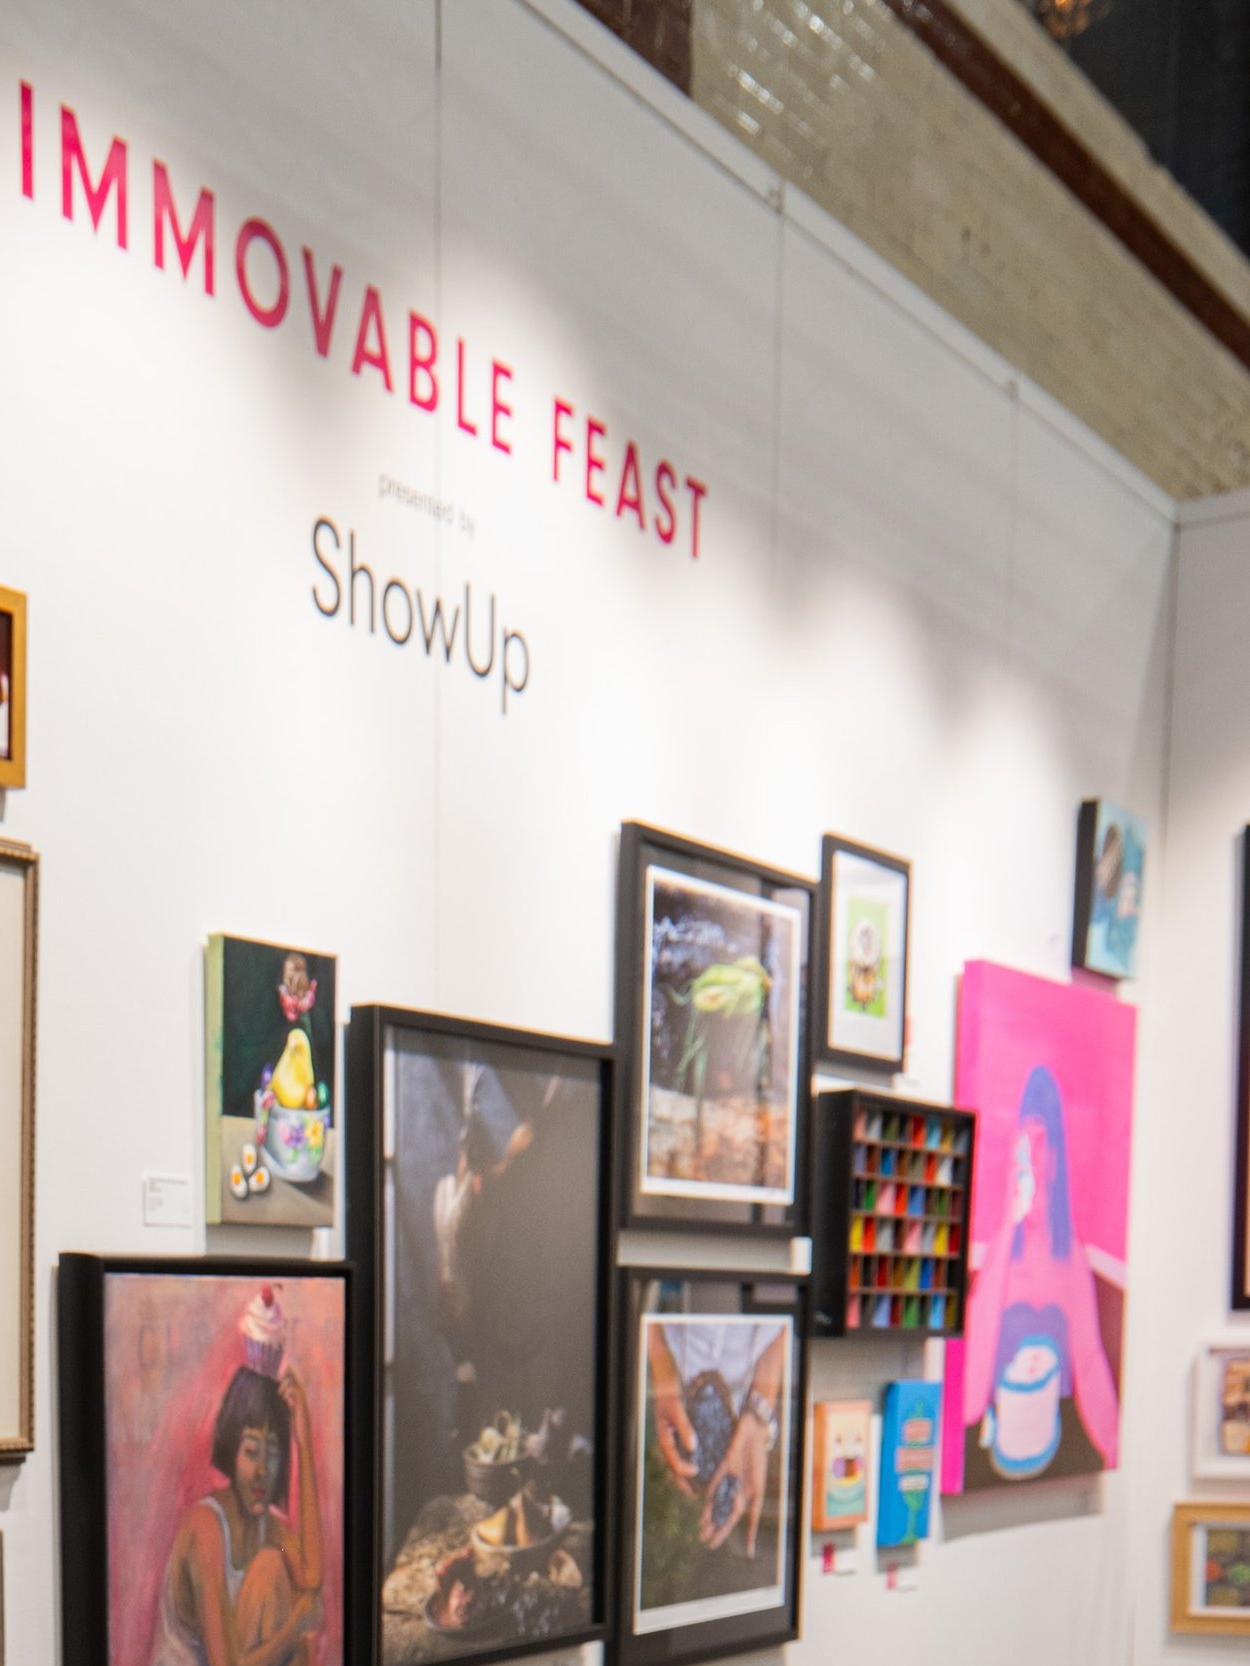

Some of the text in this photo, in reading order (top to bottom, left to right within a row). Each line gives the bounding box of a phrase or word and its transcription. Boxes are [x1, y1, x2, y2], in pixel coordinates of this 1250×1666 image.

[19, 79, 708, 559] IMMOVABLE FEAST
[379, 474, 476, 540] presented by
[312, 516, 529, 714] ShowUp
